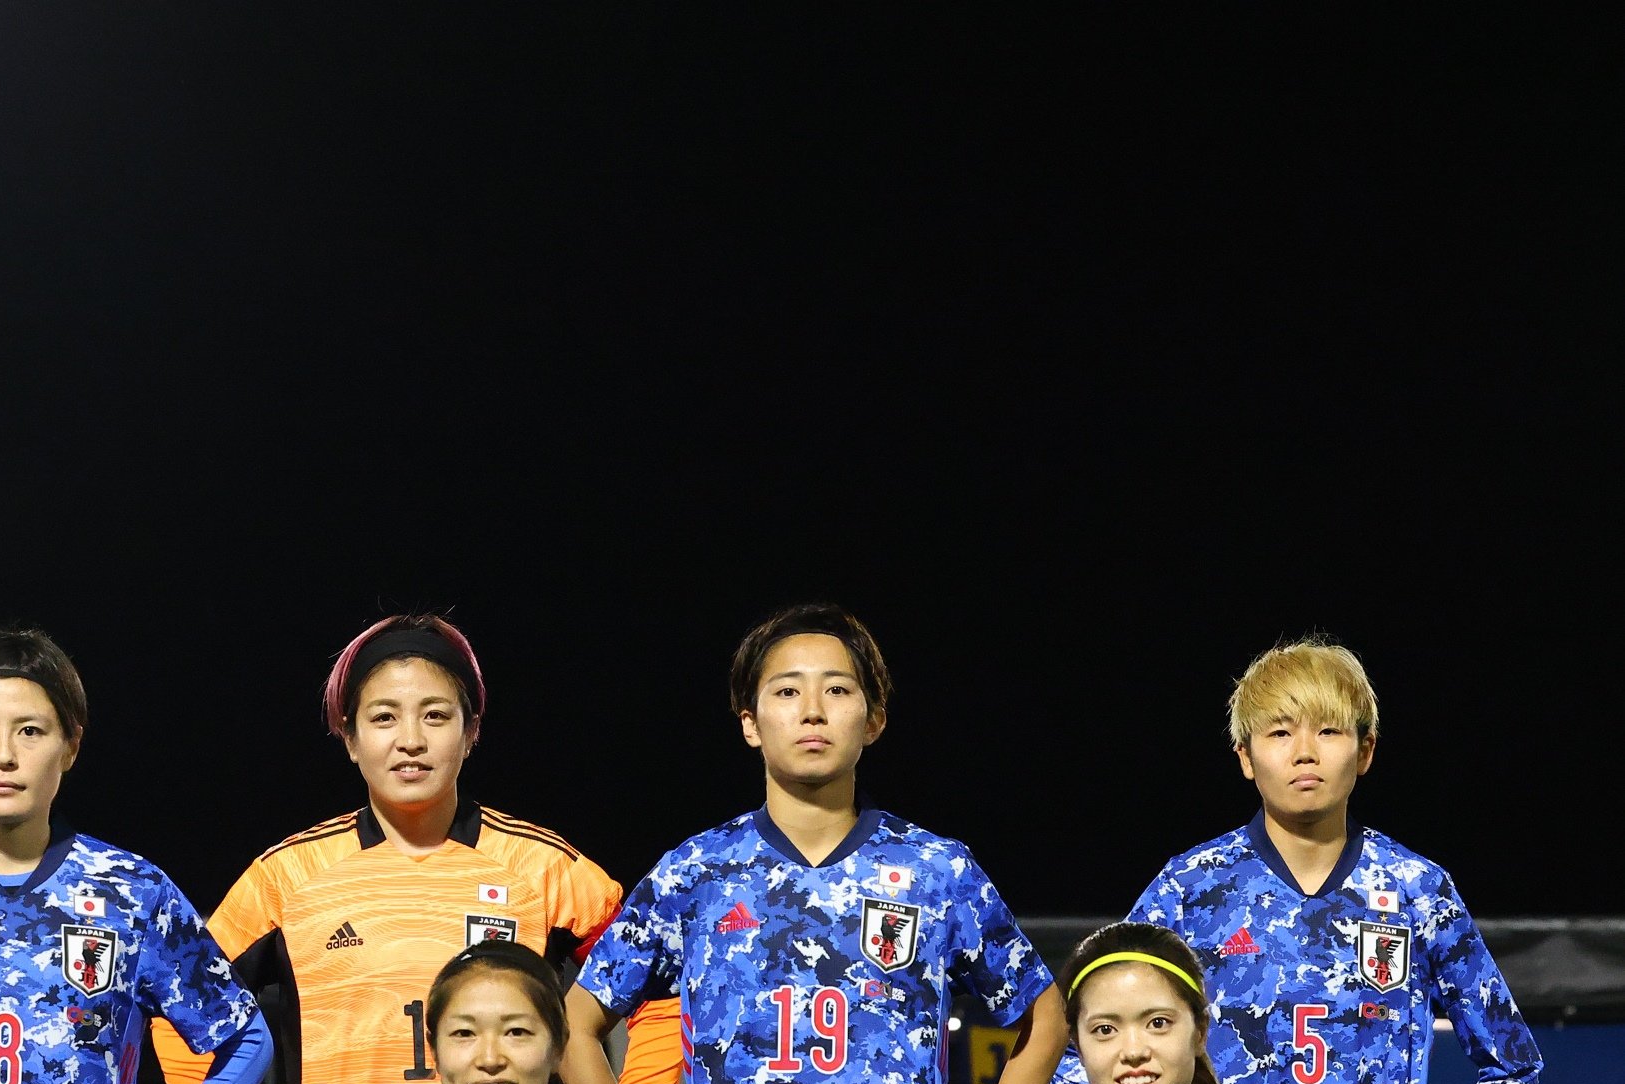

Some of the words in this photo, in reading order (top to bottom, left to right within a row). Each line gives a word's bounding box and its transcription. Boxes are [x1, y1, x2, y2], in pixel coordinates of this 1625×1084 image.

[877, 902, 906, 913] JAPAN
[479, 917, 506, 927] JAPAN
[75, 927, 105, 938] JAPAN
[1370, 925, 1398, 936] JAPAN
[326, 935, 364, 950] adidas
[767, 985, 849, 1075] 19
